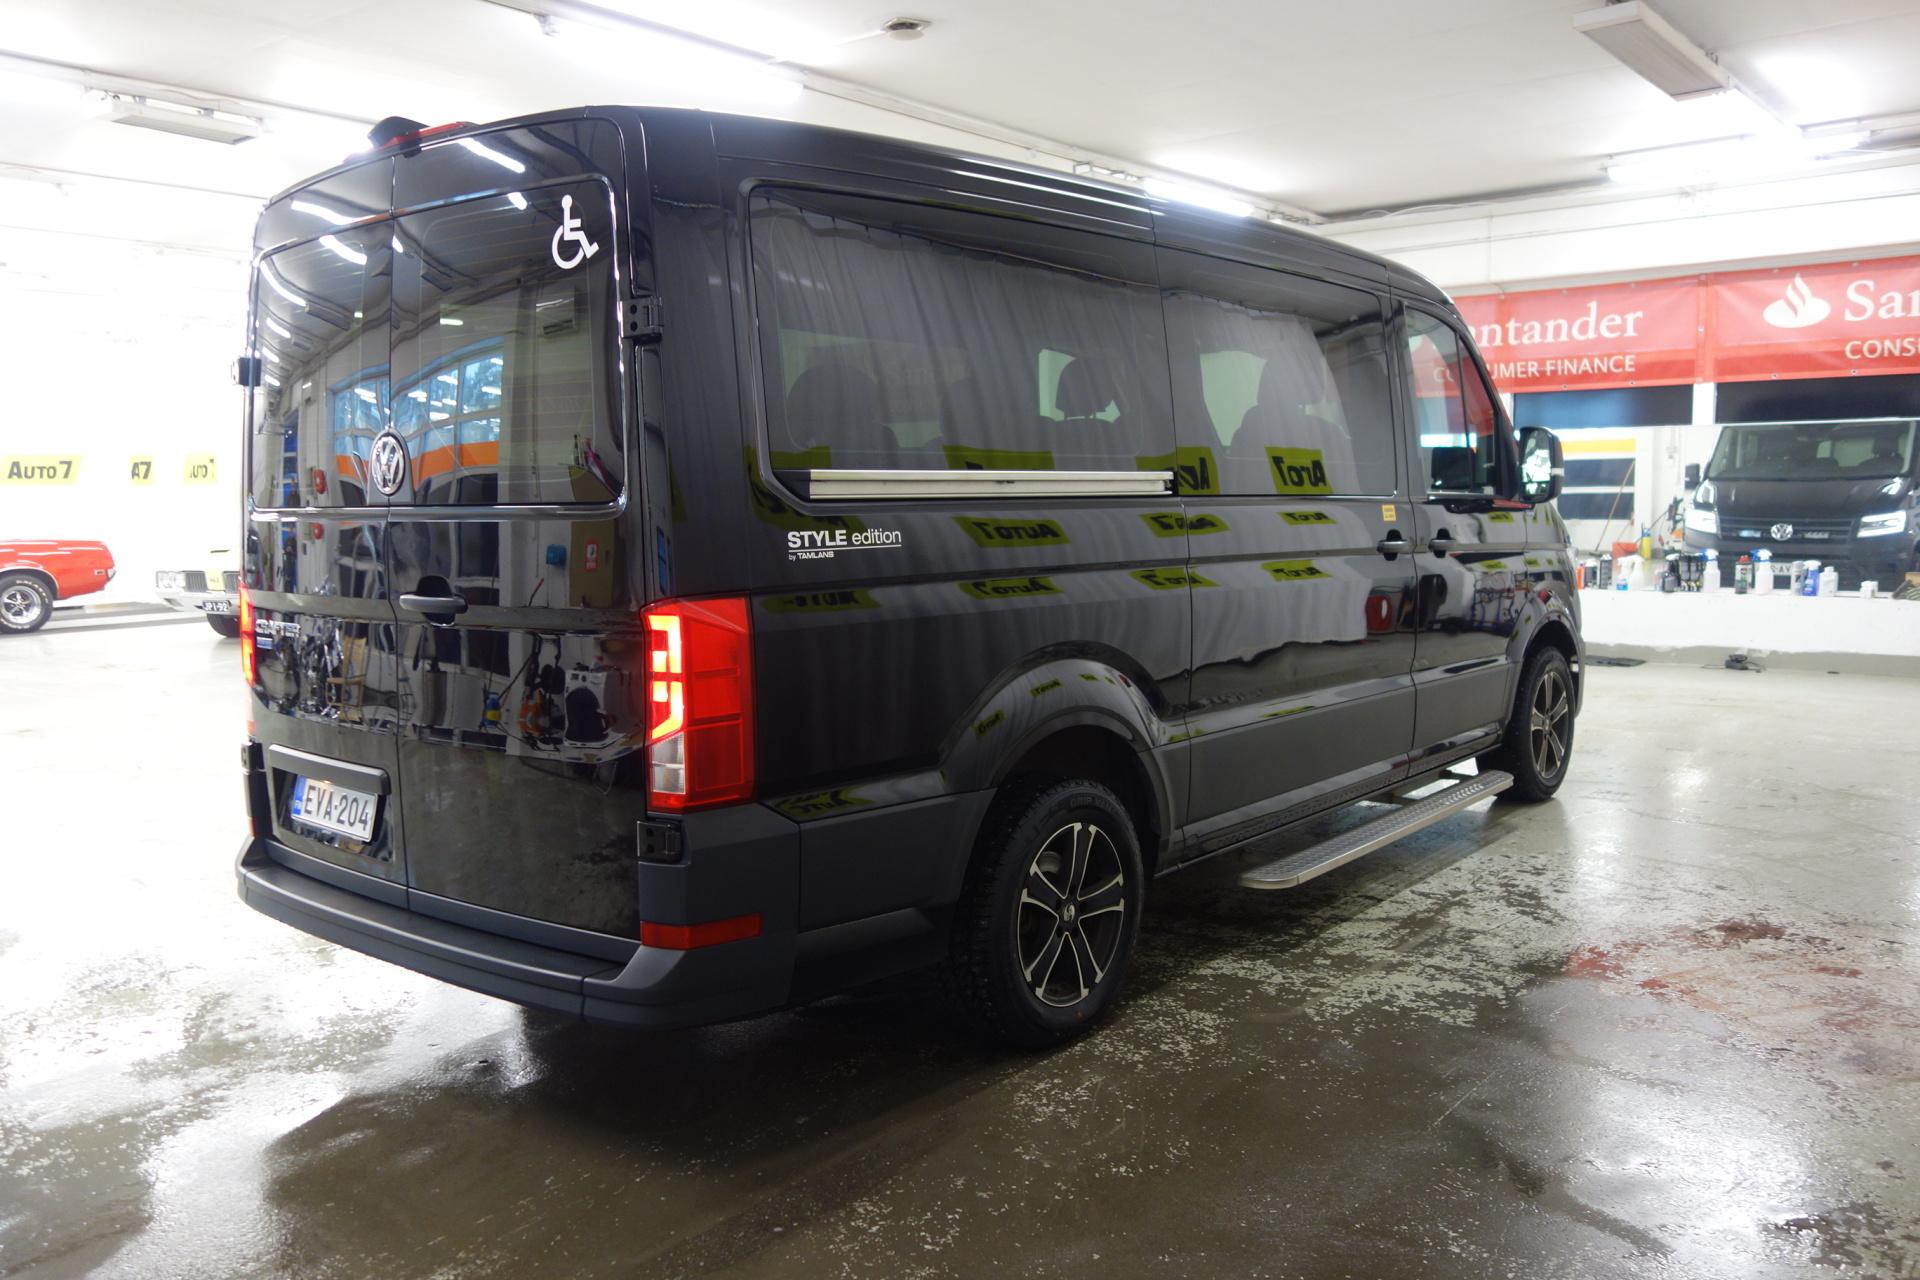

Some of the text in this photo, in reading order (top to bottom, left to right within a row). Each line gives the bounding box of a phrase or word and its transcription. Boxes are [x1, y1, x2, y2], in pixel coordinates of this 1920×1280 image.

[1469, 301, 1643, 348] ntander
[1845, 338, 1920, 359] CONS
[1546, 354, 1636, 376] FINANCE
[788, 528, 902, 549] STYLE edition
[797, 551, 835, 560] TAMLANS
[304, 784, 369, 831] EVA-204
